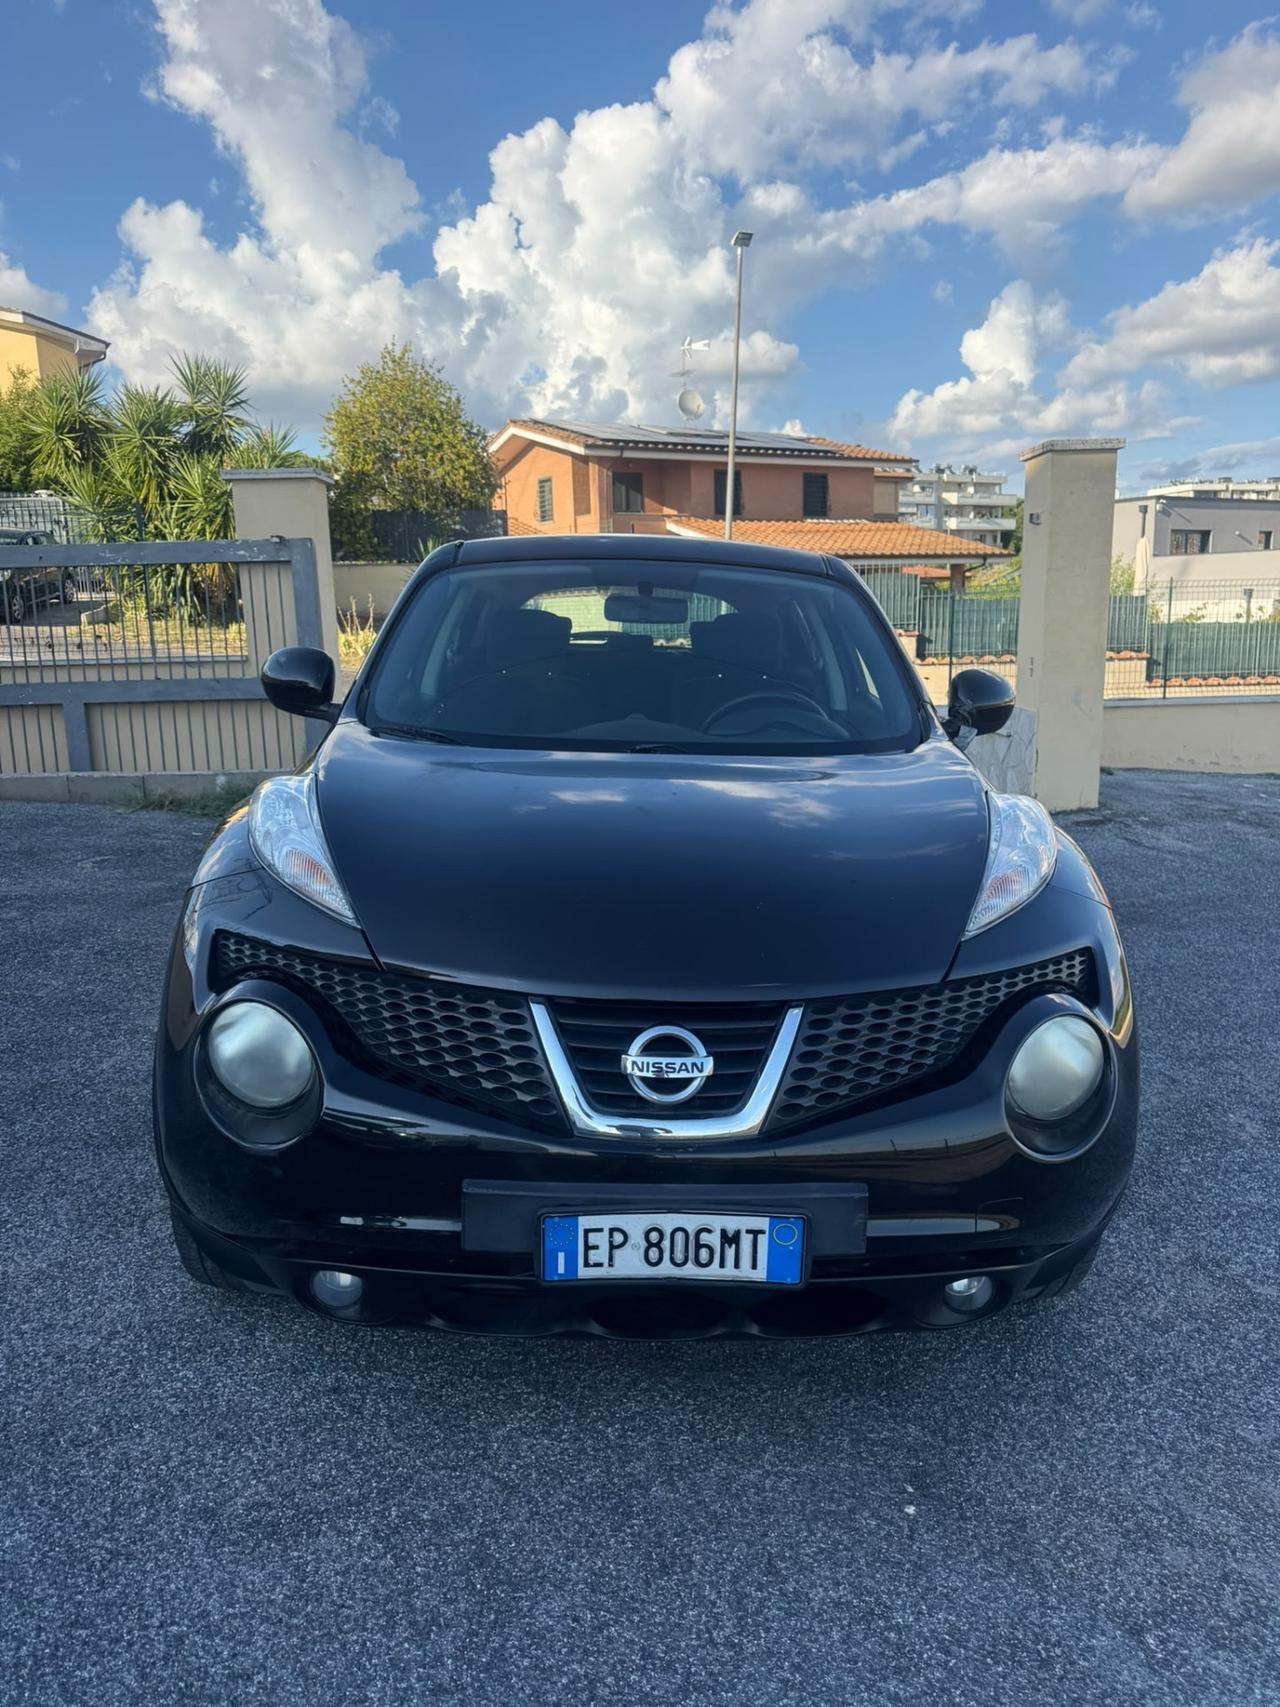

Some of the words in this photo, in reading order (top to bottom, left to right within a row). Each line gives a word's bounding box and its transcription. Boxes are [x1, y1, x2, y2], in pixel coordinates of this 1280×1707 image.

[631, 1060, 704, 1074] NISSAN
[583, 1227, 629, 1269] EP
[643, 1226, 767, 1271] 806MT
